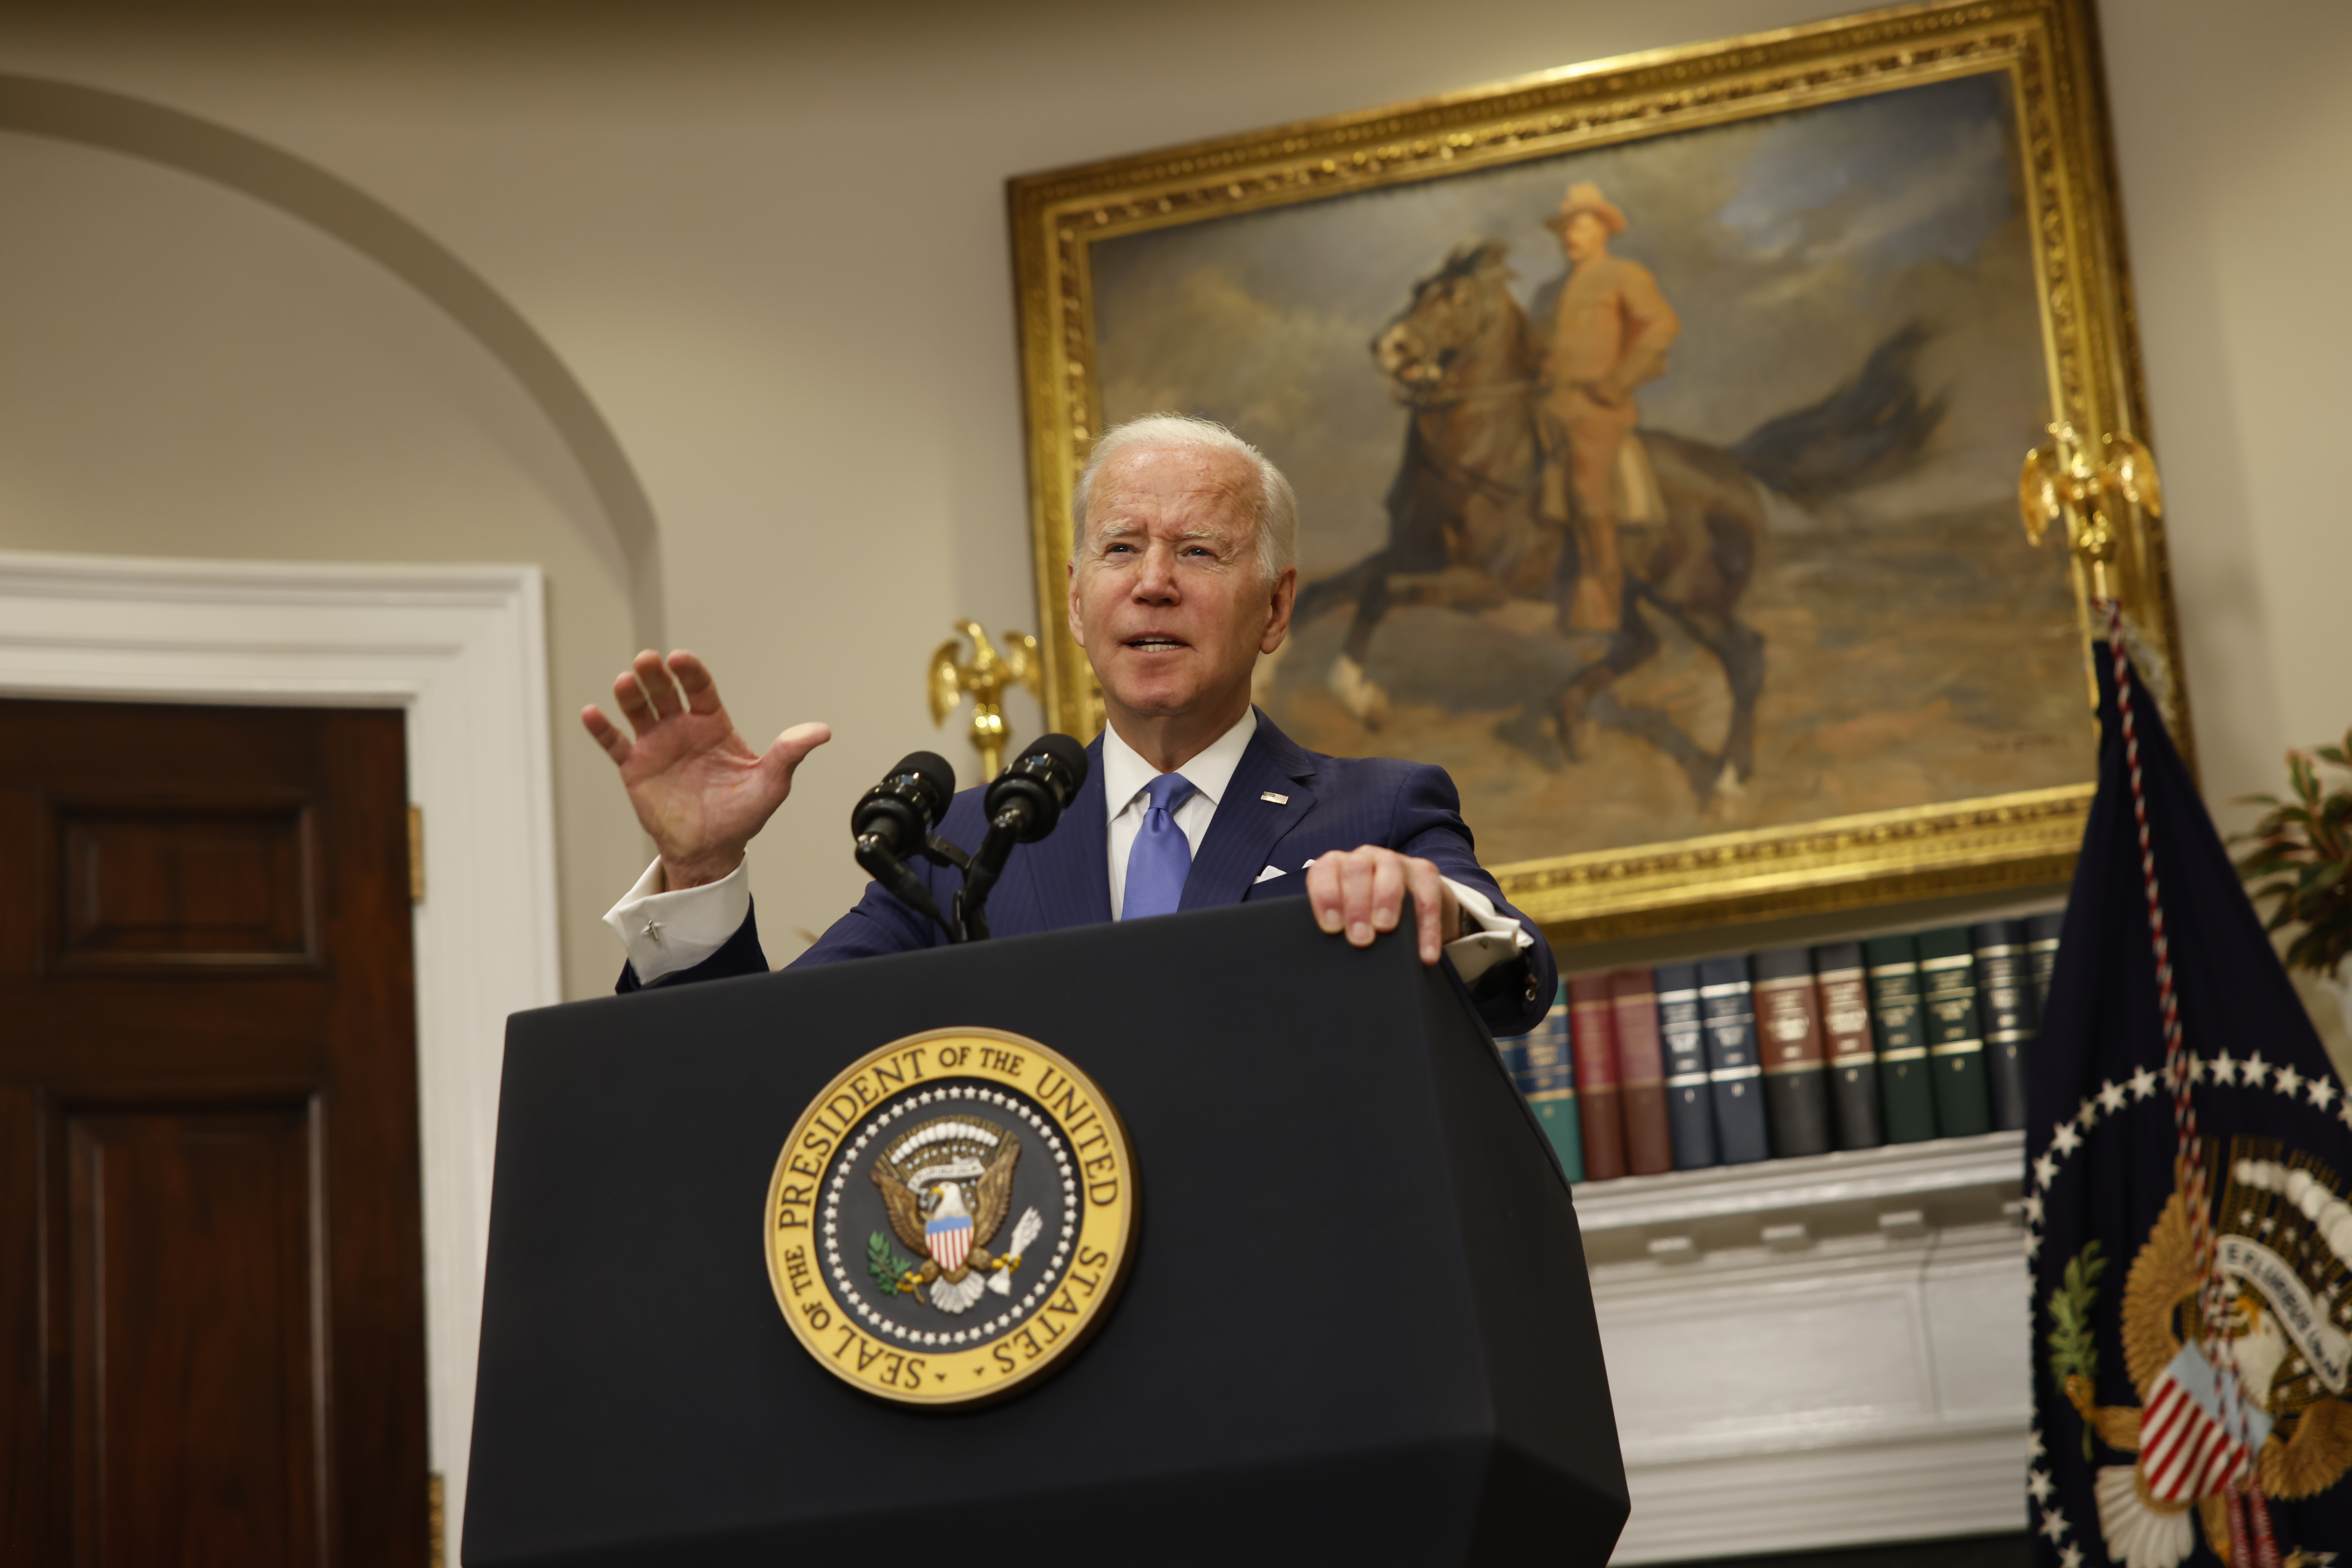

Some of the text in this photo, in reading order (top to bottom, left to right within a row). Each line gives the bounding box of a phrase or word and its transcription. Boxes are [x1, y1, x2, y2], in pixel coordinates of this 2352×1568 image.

[778, 1047, 1118, 1389] SEAL OF THE PRESIDENT OF THE UNITED STATES
